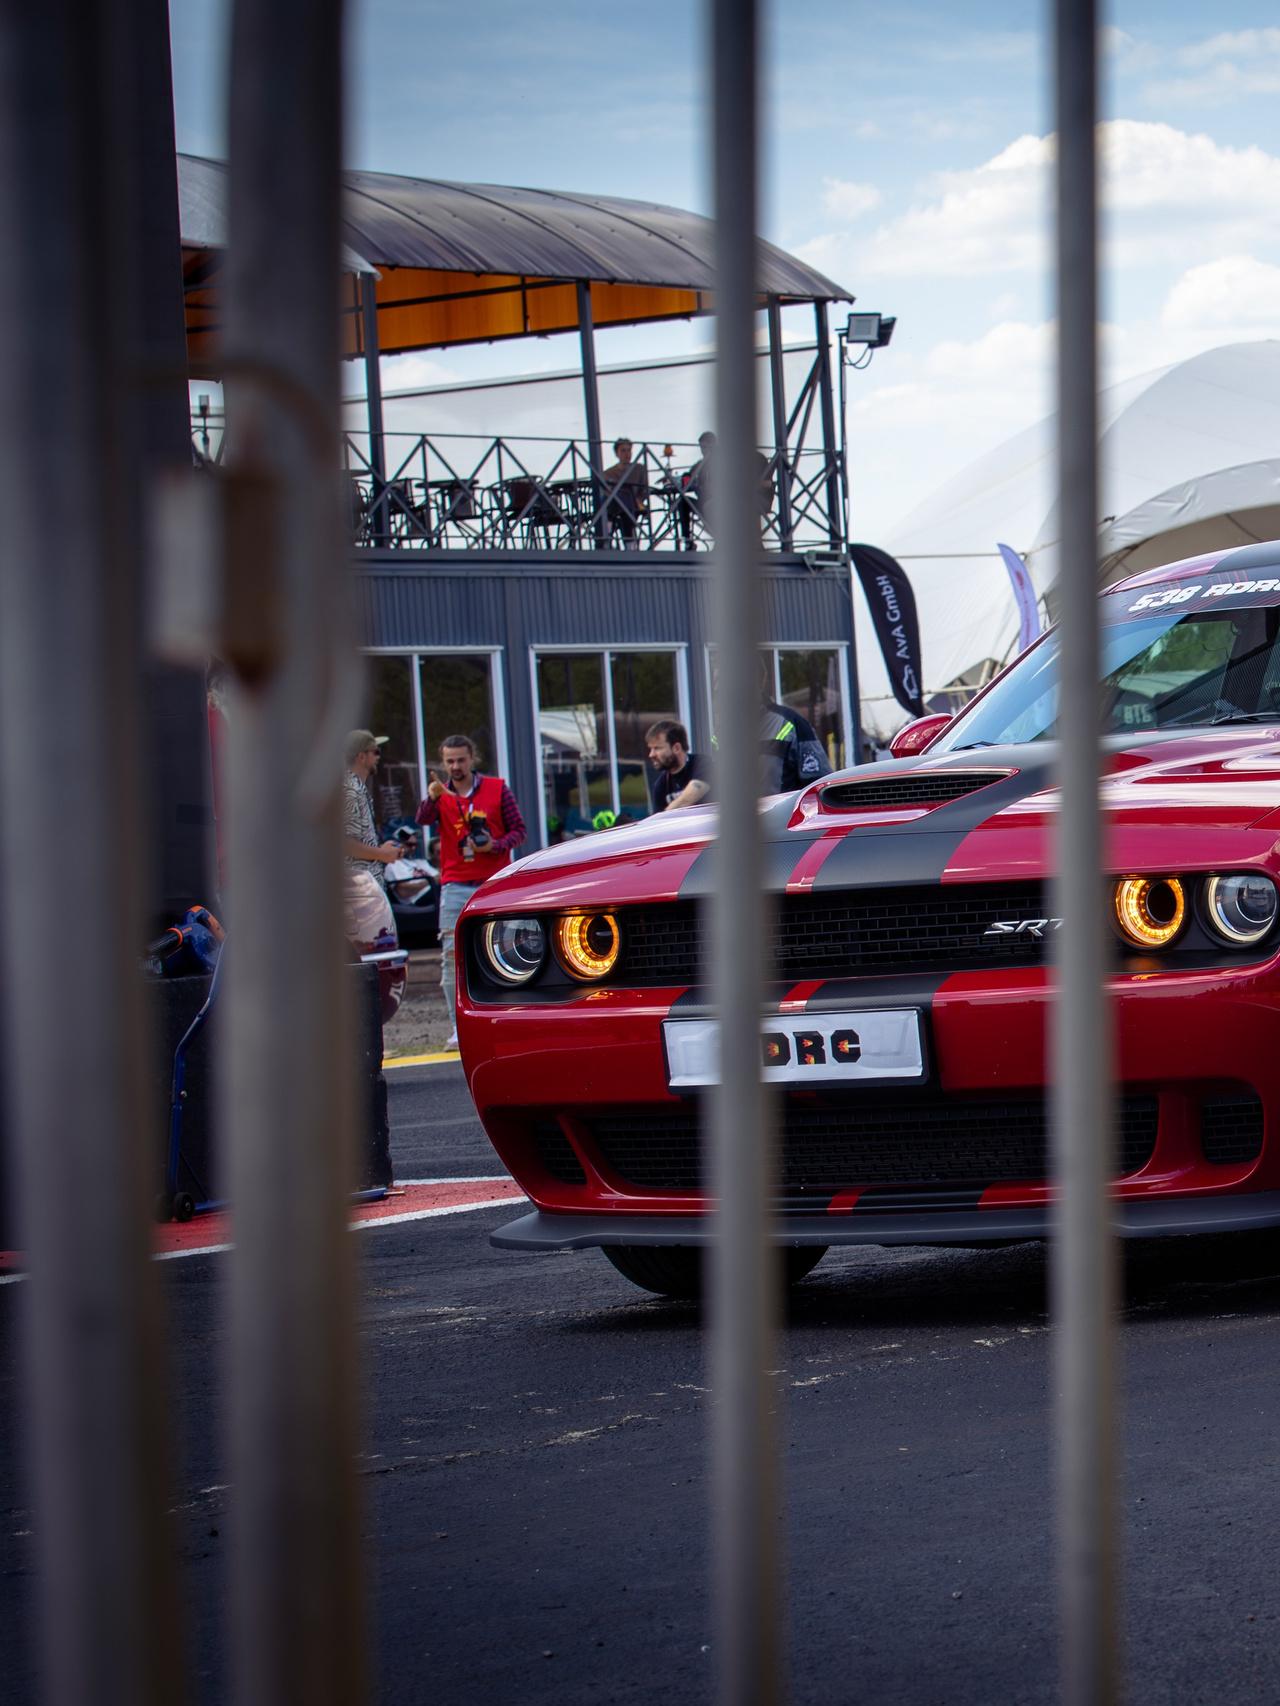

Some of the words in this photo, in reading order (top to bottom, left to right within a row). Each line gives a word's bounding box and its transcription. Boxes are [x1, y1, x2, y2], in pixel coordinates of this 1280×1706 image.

[876, 575, 901, 622] GmbH
[1128, 585, 1202, 612] 538
[761, 1029, 862, 1067] DRC
